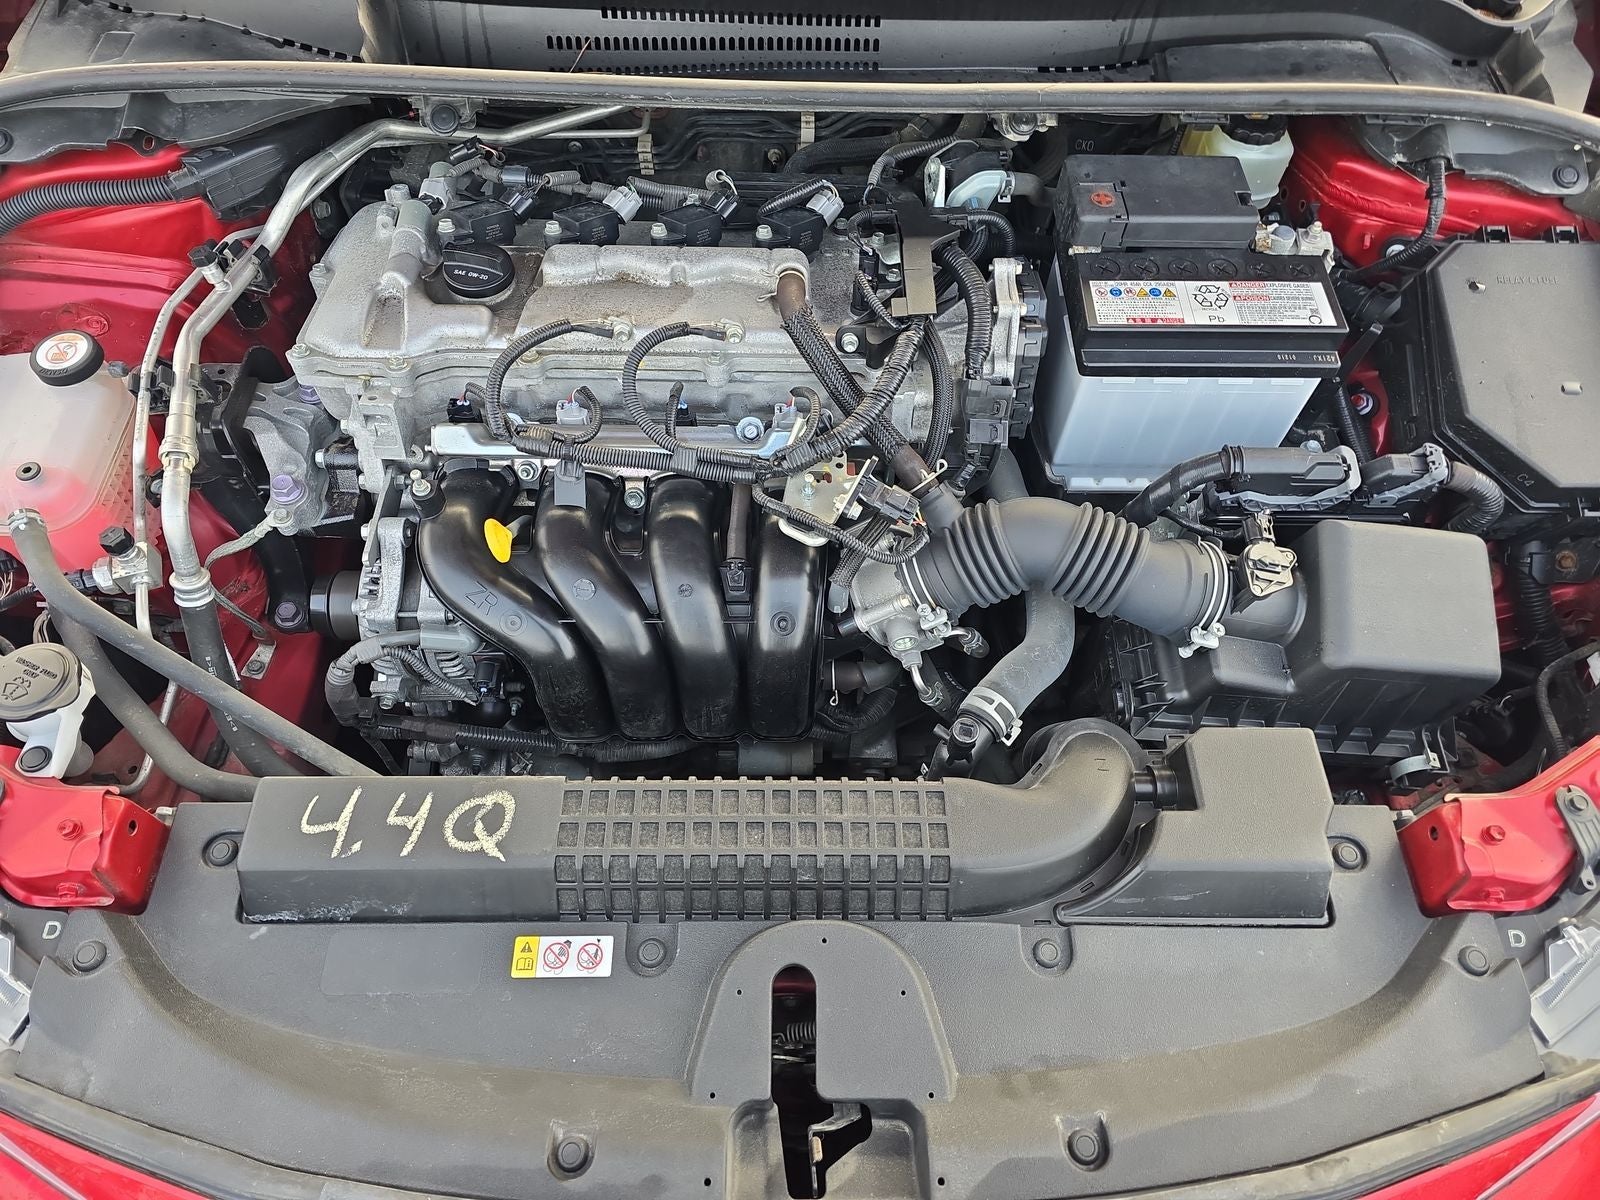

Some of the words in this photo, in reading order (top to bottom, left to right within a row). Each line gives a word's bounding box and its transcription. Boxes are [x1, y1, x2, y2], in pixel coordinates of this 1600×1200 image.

[468, 271, 489, 280] 0W-20
[1208, 315, 1225, 323] Pb
[463, 581, 499, 616] ZR
[42, 920, 61, 940] D
[1507, 929, 1526, 948] D
